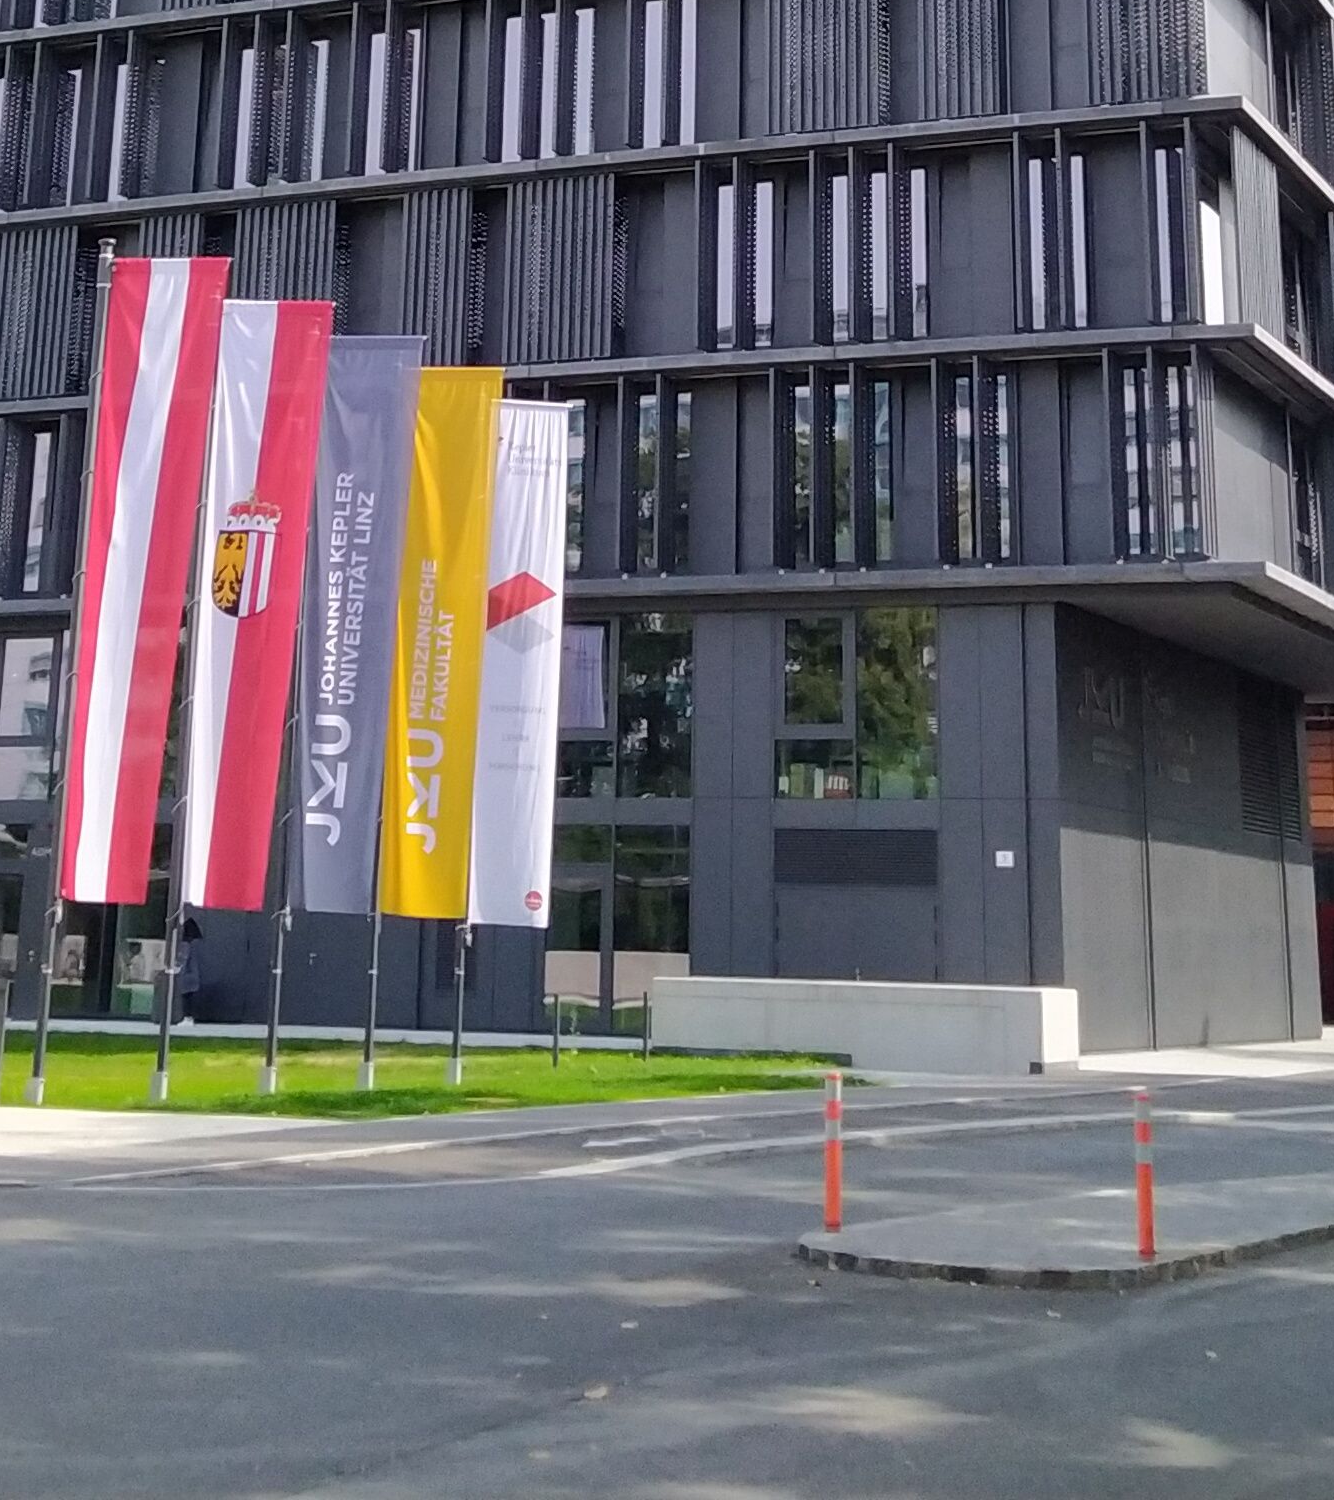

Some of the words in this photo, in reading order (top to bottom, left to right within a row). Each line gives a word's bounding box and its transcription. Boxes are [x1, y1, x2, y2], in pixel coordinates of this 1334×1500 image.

[329, 472, 355, 562] KEPLER
[319, 570, 343, 705] JOHANNES
[337, 551, 369, 705] UNIVERSITÄT
[353, 491, 375, 544] LINZ
[409, 559, 437, 719] MEDIZINISCHE
[429, 610, 455, 721] FAKULTÄT
[305, 714, 351, 846] JKU
[406, 728, 443, 854] JKU
